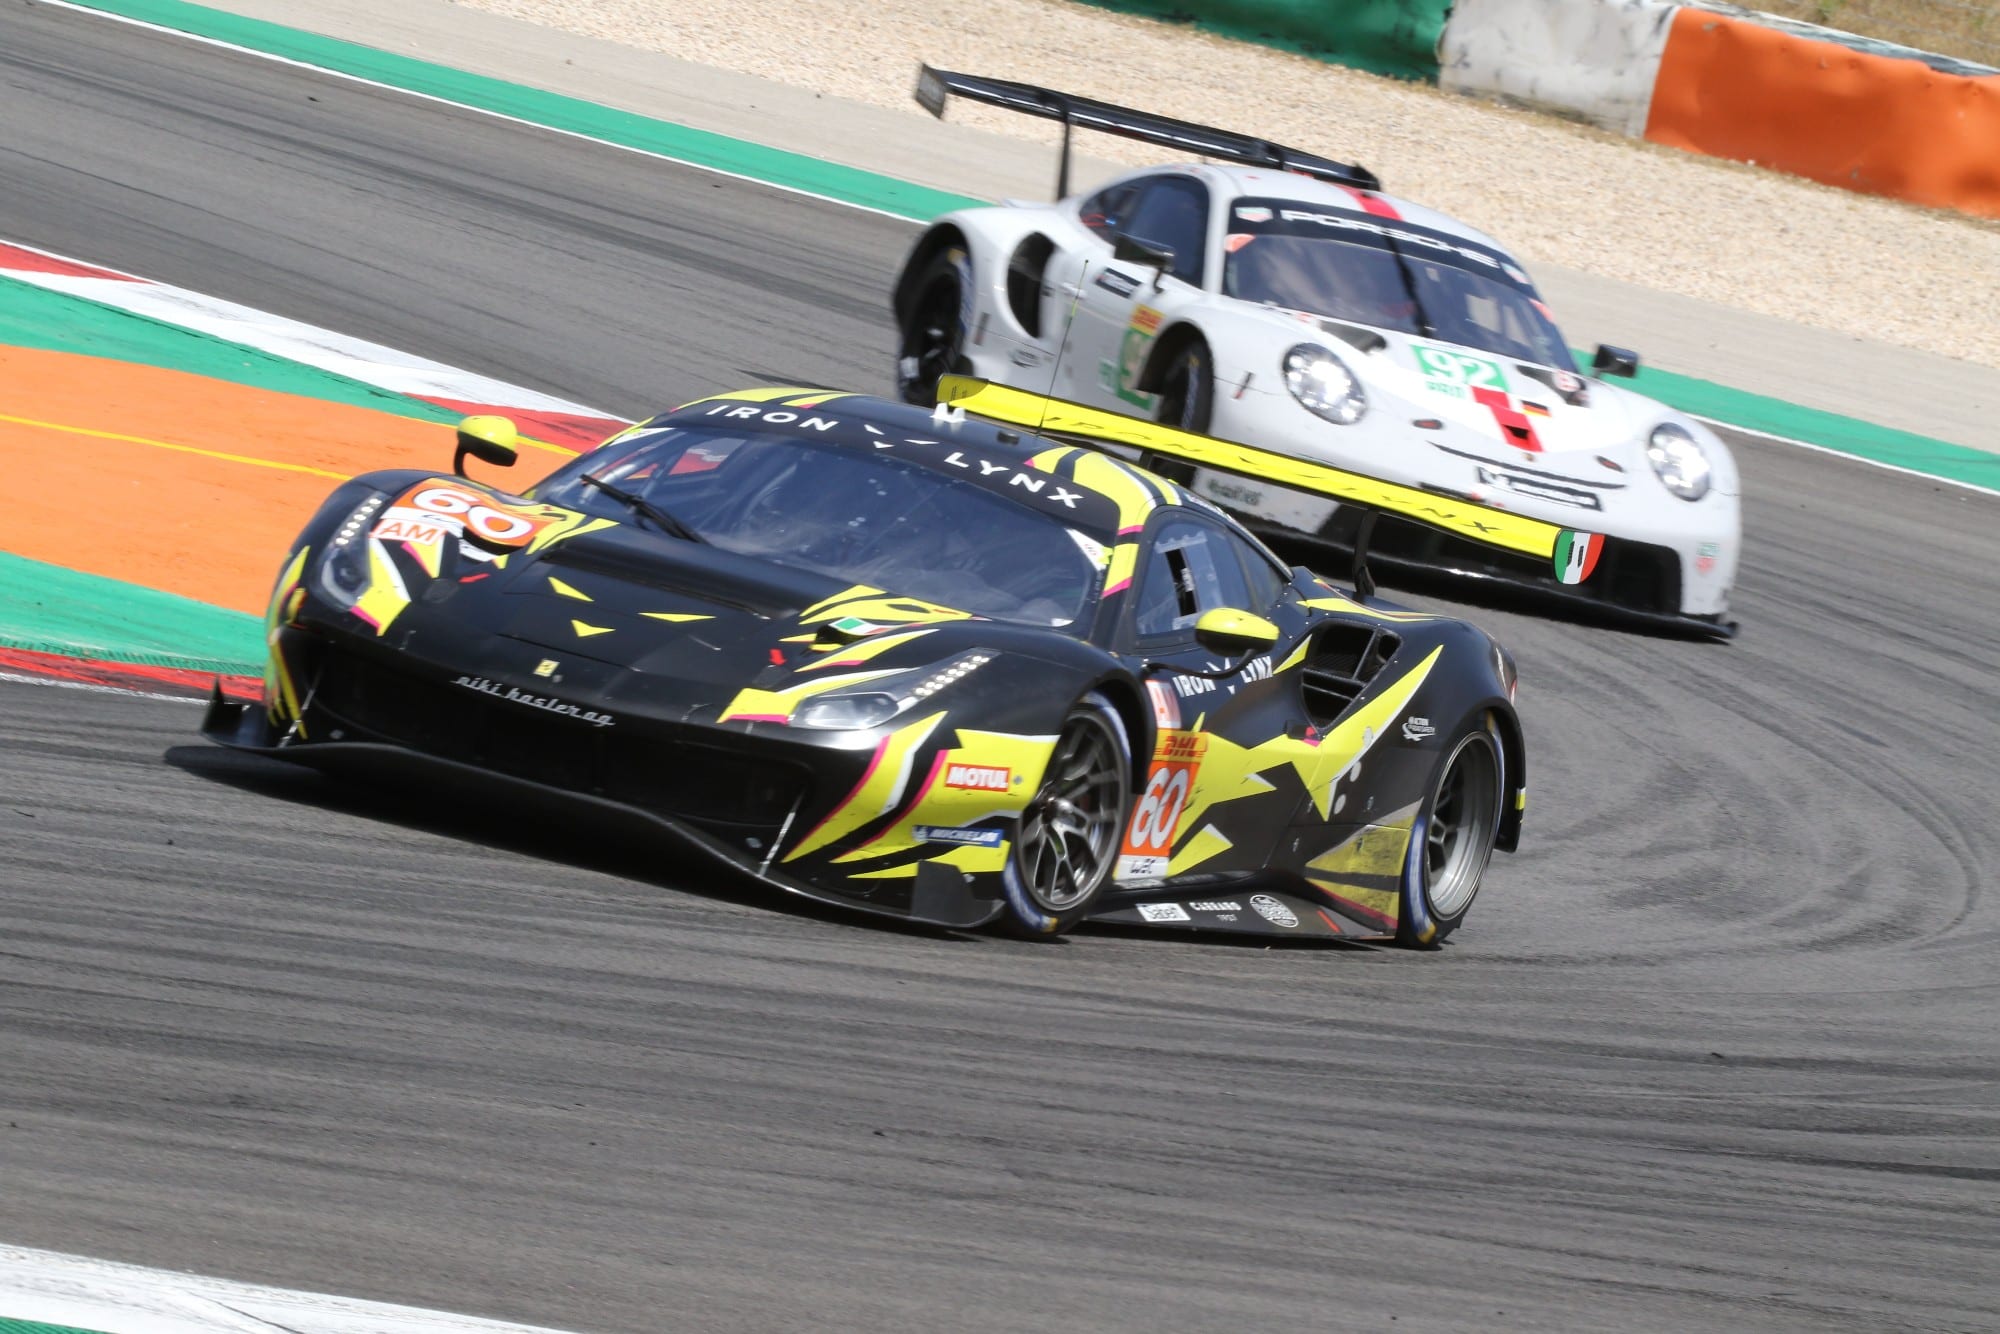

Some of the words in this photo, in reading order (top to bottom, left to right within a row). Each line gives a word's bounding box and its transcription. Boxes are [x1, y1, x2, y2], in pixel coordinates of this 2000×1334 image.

[1281, 209, 1501, 269] PORSCHE
[1421, 348, 1505, 391] 92
[706, 404, 840, 432] IRON
[944, 452, 1084, 509] LYNX
[380, 522, 439, 542] AM
[413, 488, 534, 540] 60
[1171, 674, 1217, 697] IRON
[1162, 735, 1199, 757] DHL
[946, 766, 1009, 789] MOTUL
[1130, 767, 1189, 849] 60
